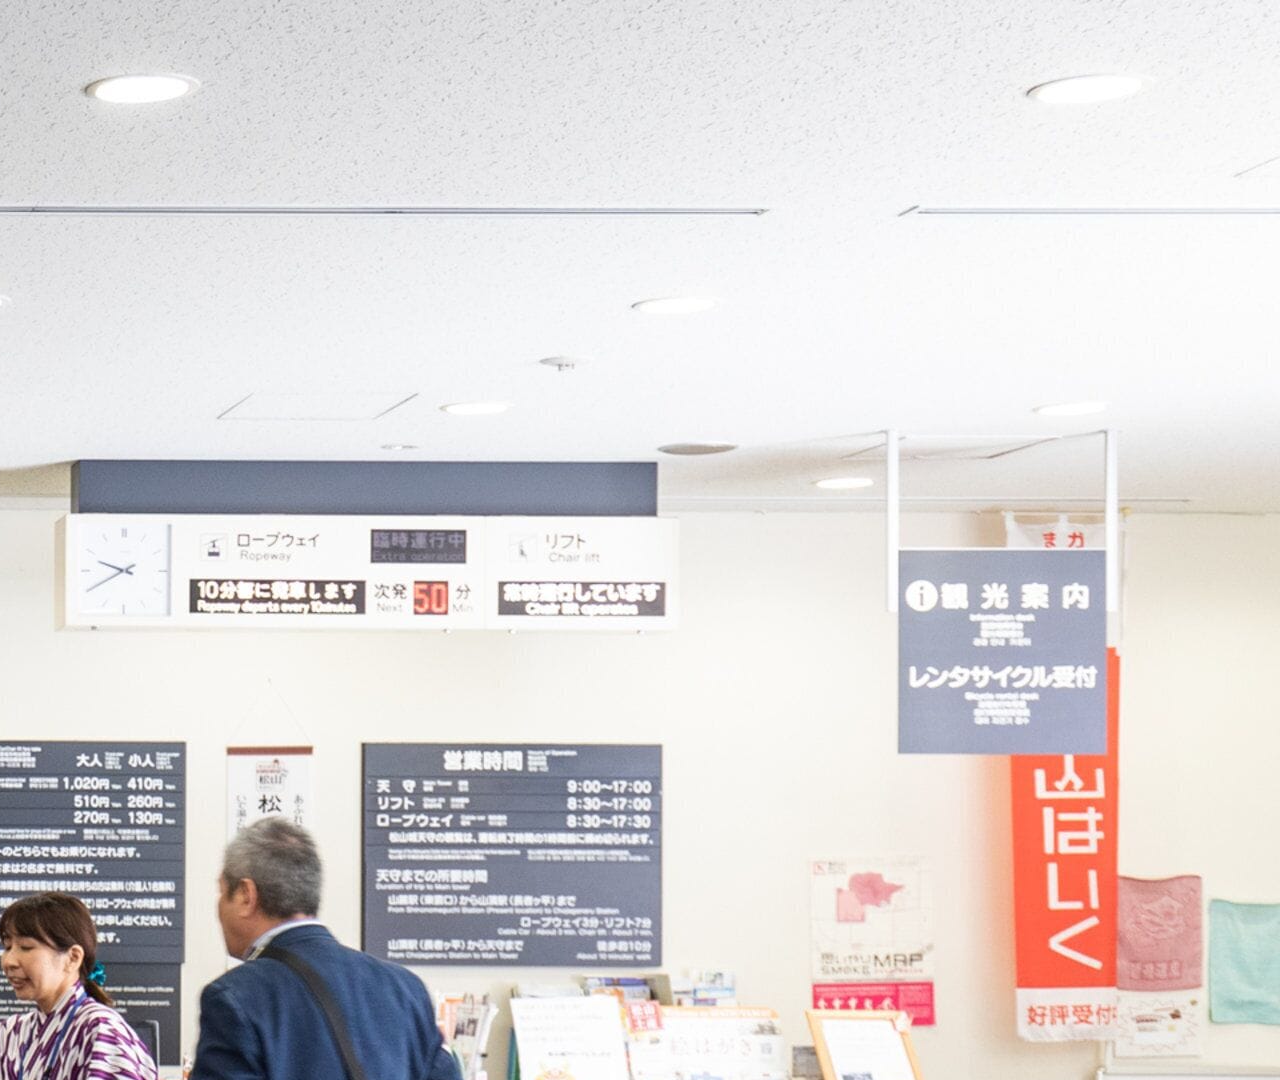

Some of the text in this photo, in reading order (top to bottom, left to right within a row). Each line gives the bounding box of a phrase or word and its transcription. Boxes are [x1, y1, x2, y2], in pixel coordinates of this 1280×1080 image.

[237, 533, 320, 548] ロープウェイ
[545, 535, 586, 549] リフト
[239, 549, 292, 562] Ropeway
[548, 551, 583, 564] Chair
[374, 584, 408, 600] 次発
[413, 582, 448, 614] 50
[455, 584, 471, 600] 分
[941, 582, 1090, 610] 観光案内
[908, 664, 1098, 688] レンタサイクル受付
[76, 753, 102, 767] 大人
[128, 753, 154, 767] 小人
[442, 751, 523, 771] 営業時間
[62, 777, 109, 790] 1,020円
[127, 777, 164, 790] 410円
[566, 780, 652, 793] 9:00～17:00
[73, 795, 110, 808] 510円
[127, 795, 164, 809] 260円
[258, 794, 282, 813] 松
[377, 797, 415, 810] リフト
[566, 797, 652, 811] 8:30～17:00
[73, 811, 110, 824] 270円
[127, 812, 164, 825] 130円
[376, 814, 454, 828] ロープウェイ
[566, 814, 651, 828] 8:30～17:30
[1026, 1004, 1117, 1025] 好評受付
